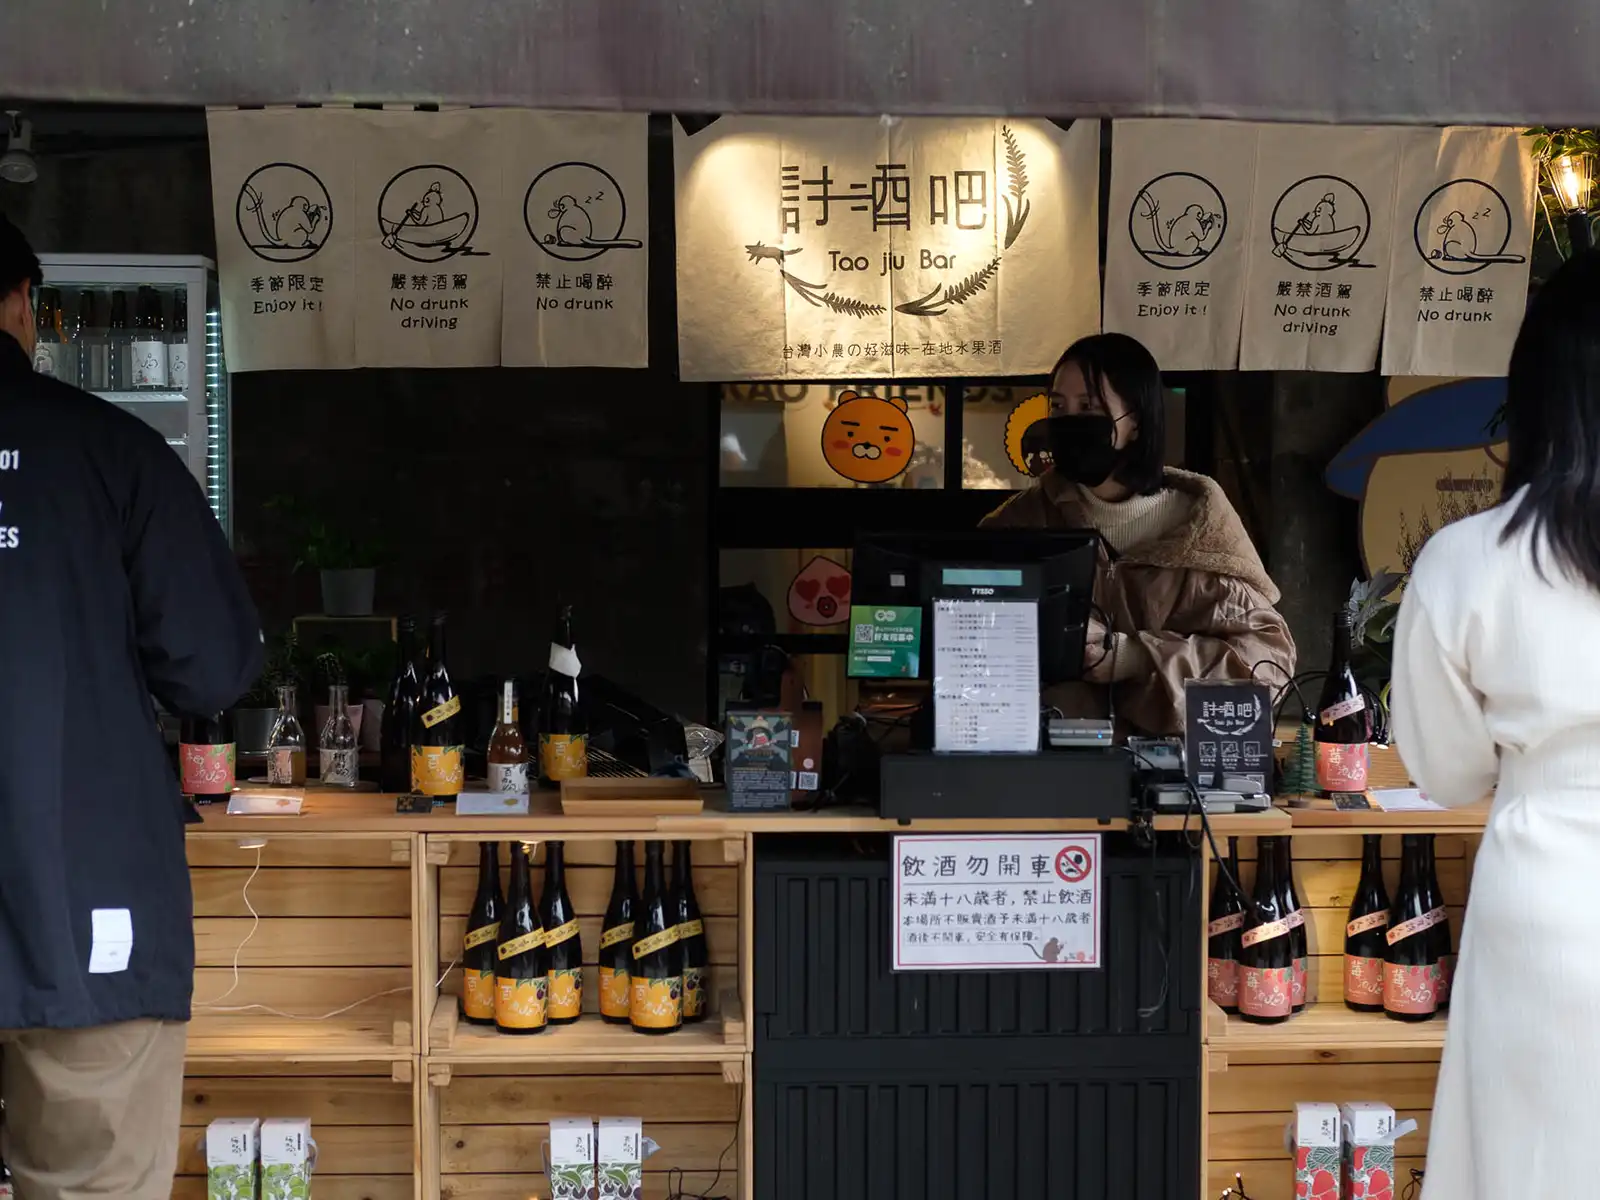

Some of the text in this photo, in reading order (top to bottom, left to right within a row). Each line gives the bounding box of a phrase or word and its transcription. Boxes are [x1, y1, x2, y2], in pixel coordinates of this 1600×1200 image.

[828, 249, 957, 276] Tao jiu Bar
[249, 274, 324, 293] 季節限定
[390, 273, 468, 291] 嚴禁酒駕
[535, 273, 614, 291] 禁止喝醉
[1136, 280, 1210, 297] 季節限定
[1275, 281, 1353, 300] 嚴禁酒駕
[1419, 285, 1494, 304] 禁止喝醉
[252, 298, 323, 314] Enjoy it!
[390, 297, 469, 311] No drunk
[536, 297, 614, 311] No drunk
[1137, 303, 1179, 318] Enjoy
[1273, 303, 1351, 318] No drunk
[400, 315, 458, 330] driving
[1417, 309, 1493, 322] No drunk
[1282, 321, 1339, 336] driving
[902, 854, 1051, 878] 飲酒勿開車
